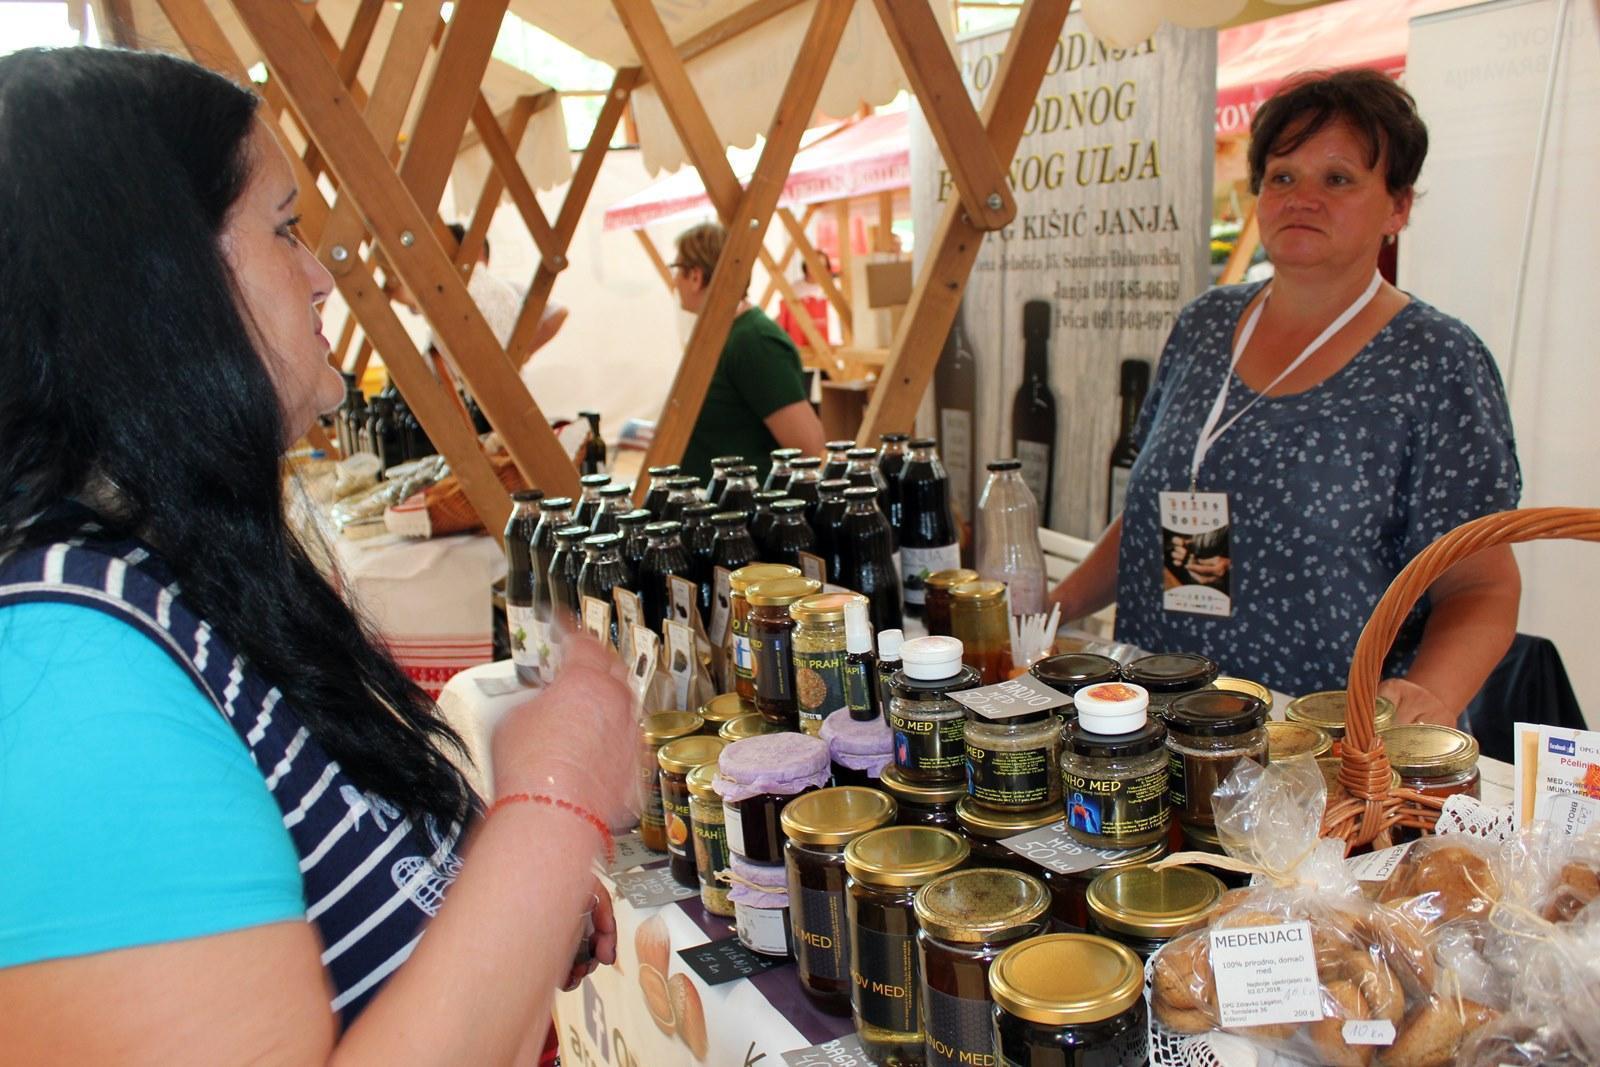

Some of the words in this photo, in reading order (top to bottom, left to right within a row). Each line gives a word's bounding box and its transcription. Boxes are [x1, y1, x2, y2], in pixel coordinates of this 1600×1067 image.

[1076, 139, 1161, 187] ULJA
[1023, 204, 1087, 241] KIŠIĆ
[1095, 203, 1180, 237] JANJA
[809, 657, 840, 670] PRAH
[998, 680, 1052, 706] CARDIO
[907, 721, 934, 733] MED
[1089, 781, 1121, 793] MED
[1547, 777, 1563, 785] MED
[1567, 801, 1578, 825] BROJ
[1015, 841, 1057, 859] 50
[1046, 837, 1082, 856] MED
[801, 929, 832, 948] MED
[1215, 928, 1303, 949] MEDENJACI
[1222, 961, 1243, 969] 100%
[1244, 958, 1277, 969] prirodno,
[873, 983, 905, 998] MED
[1309, 1010, 1315, 1018] g
[1349, 1023, 1368, 1037] 10
[959, 1053, 994, 1067] MED
